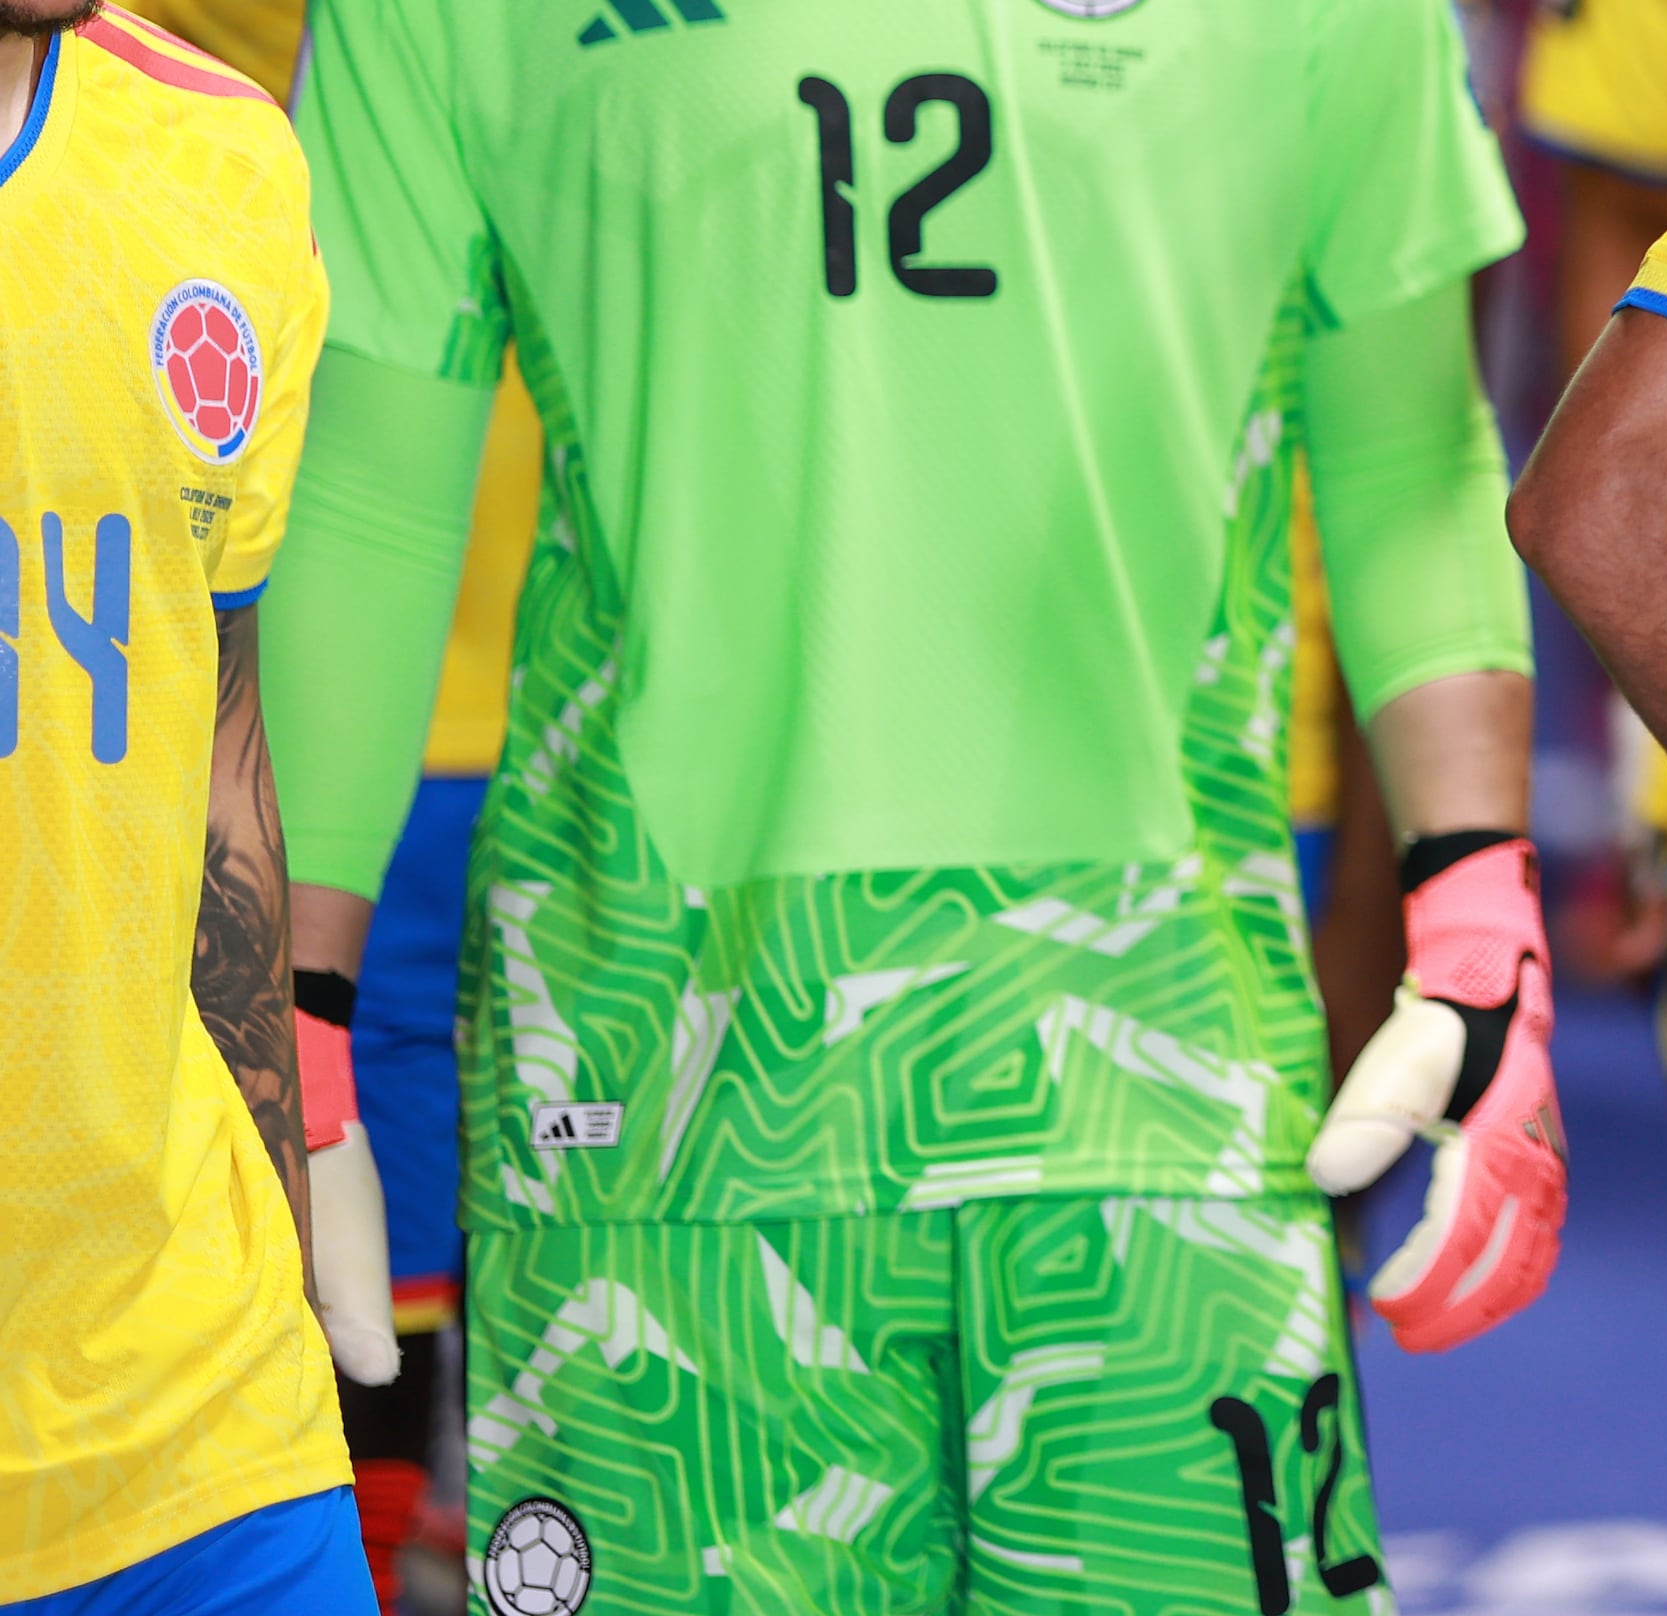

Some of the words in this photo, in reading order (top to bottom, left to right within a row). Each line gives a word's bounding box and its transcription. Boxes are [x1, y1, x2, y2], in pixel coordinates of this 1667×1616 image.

[798, 73, 998, 297] 12
[177, 286, 231, 311] COLOMBIANA
[231, 306, 242, 324] DE
[1210, 1373, 1379, 1616] 12
